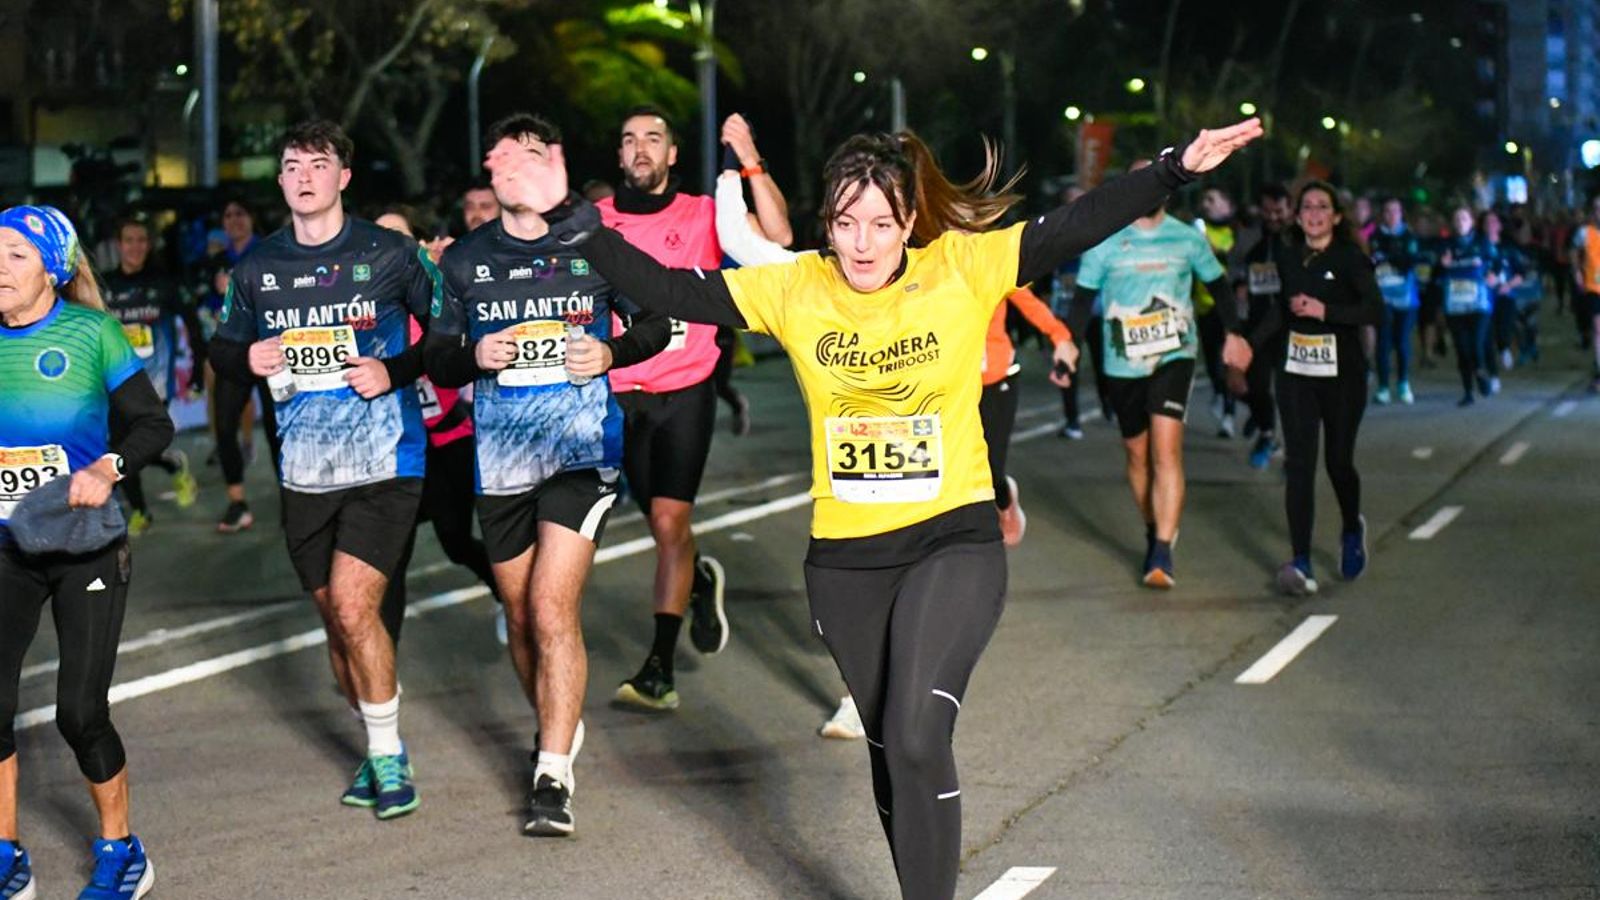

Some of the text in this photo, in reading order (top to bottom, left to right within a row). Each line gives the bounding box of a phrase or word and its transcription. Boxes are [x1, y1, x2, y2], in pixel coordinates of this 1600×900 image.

[264, 294, 377, 329] SAN ANTÓN
[476, 291, 594, 321] SAN ANTÓN
[837, 332, 859, 349] LA
[1128, 321, 1170, 341] 6857
[285, 344, 350, 367] 9896
[830, 331, 939, 367] MELONERA
[1292, 343, 1331, 361] 7048
[878, 349, 941, 375] TRIBOOST
[851, 423, 869, 436] 42
[838, 441, 932, 470] 3154
